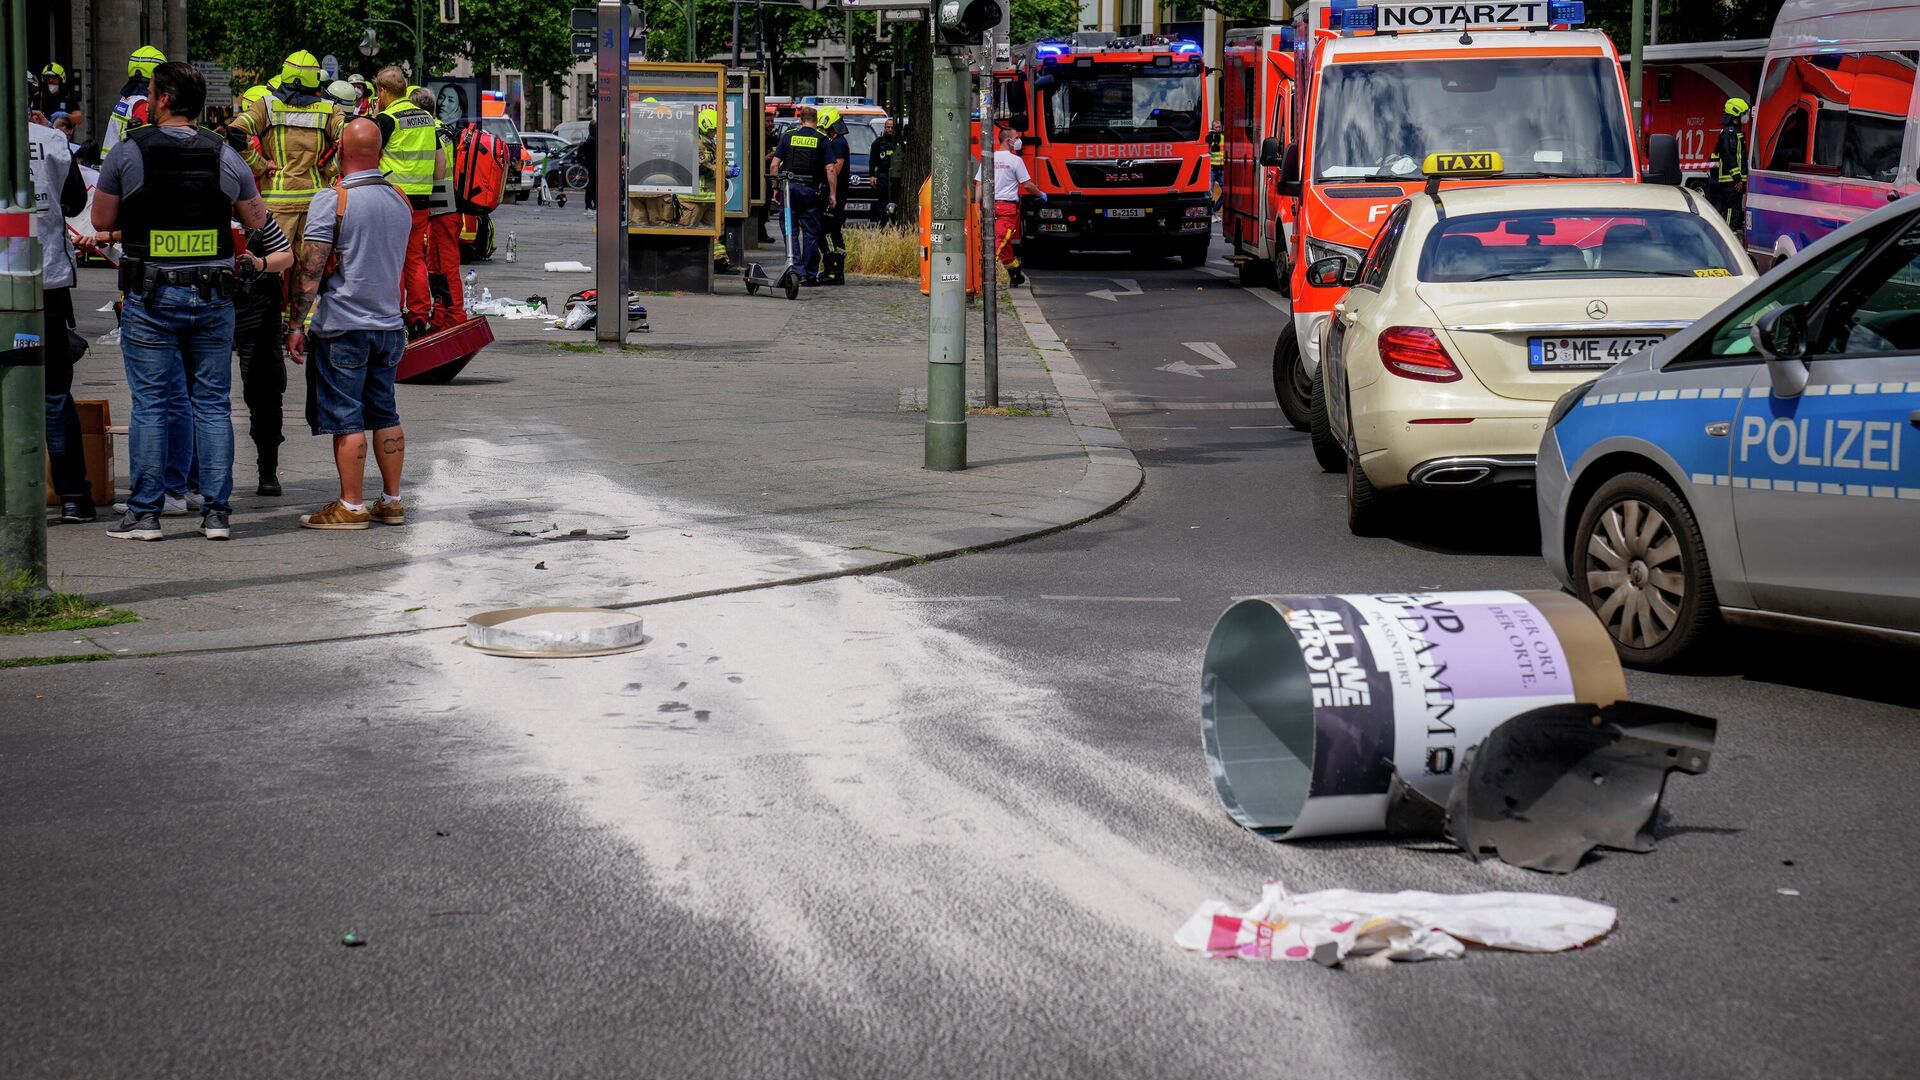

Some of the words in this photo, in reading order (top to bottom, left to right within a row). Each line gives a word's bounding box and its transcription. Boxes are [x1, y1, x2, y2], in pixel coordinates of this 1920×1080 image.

[1384, 3, 1541, 26] NOTARZT
[406, 116, 431, 127] NOTARZT
[792, 136, 817, 147] POLIZEI
[1075, 143, 1173, 158] FEUERWEHR
[1676, 129, 1705, 160] 112
[1439, 154, 1490, 171] TAXI
[1105, 173, 1143, 181] MAN
[154, 234, 214, 253] POLIZEI
[1544, 341, 1557, 362] B
[1573, 340, 1601, 361] ME
[1740, 415, 1902, 471] POLIZEI
[1488, 606, 1515, 631] DER
[1509, 635, 1537, 689] ORTE.
[1513, 609, 1540, 636] DER
[1533, 640, 1558, 680] ORT
[1289, 608, 1341, 708] WROTE
[1309, 608, 1355, 658] ALL
[1334, 656, 1371, 707] WE
